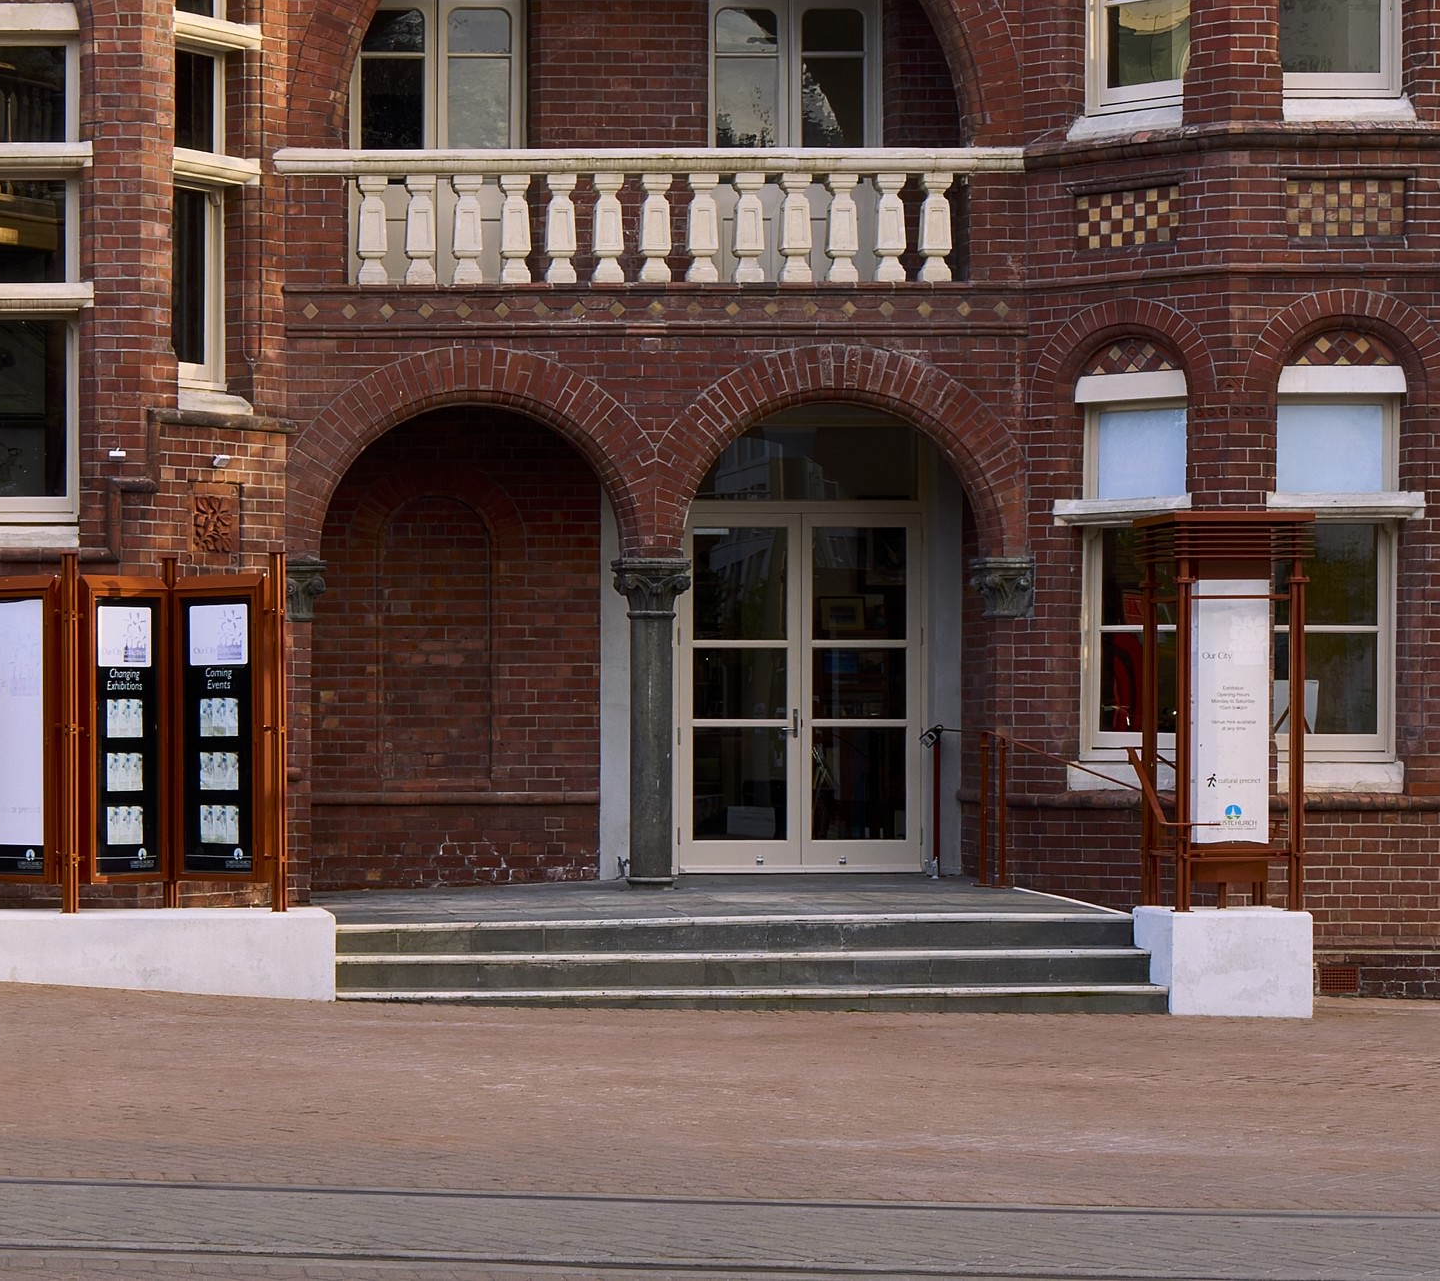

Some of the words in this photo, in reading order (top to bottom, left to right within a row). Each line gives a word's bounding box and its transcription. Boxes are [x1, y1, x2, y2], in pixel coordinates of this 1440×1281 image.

[1201, 651, 1216, 660] Our
[1217, 651, 1232, 661] City
[109, 668, 140, 681] Changing
[205, 667, 232, 679] Coming
[106, 680, 143, 691] Exhibitions
[207, 679, 231, 690] Events
